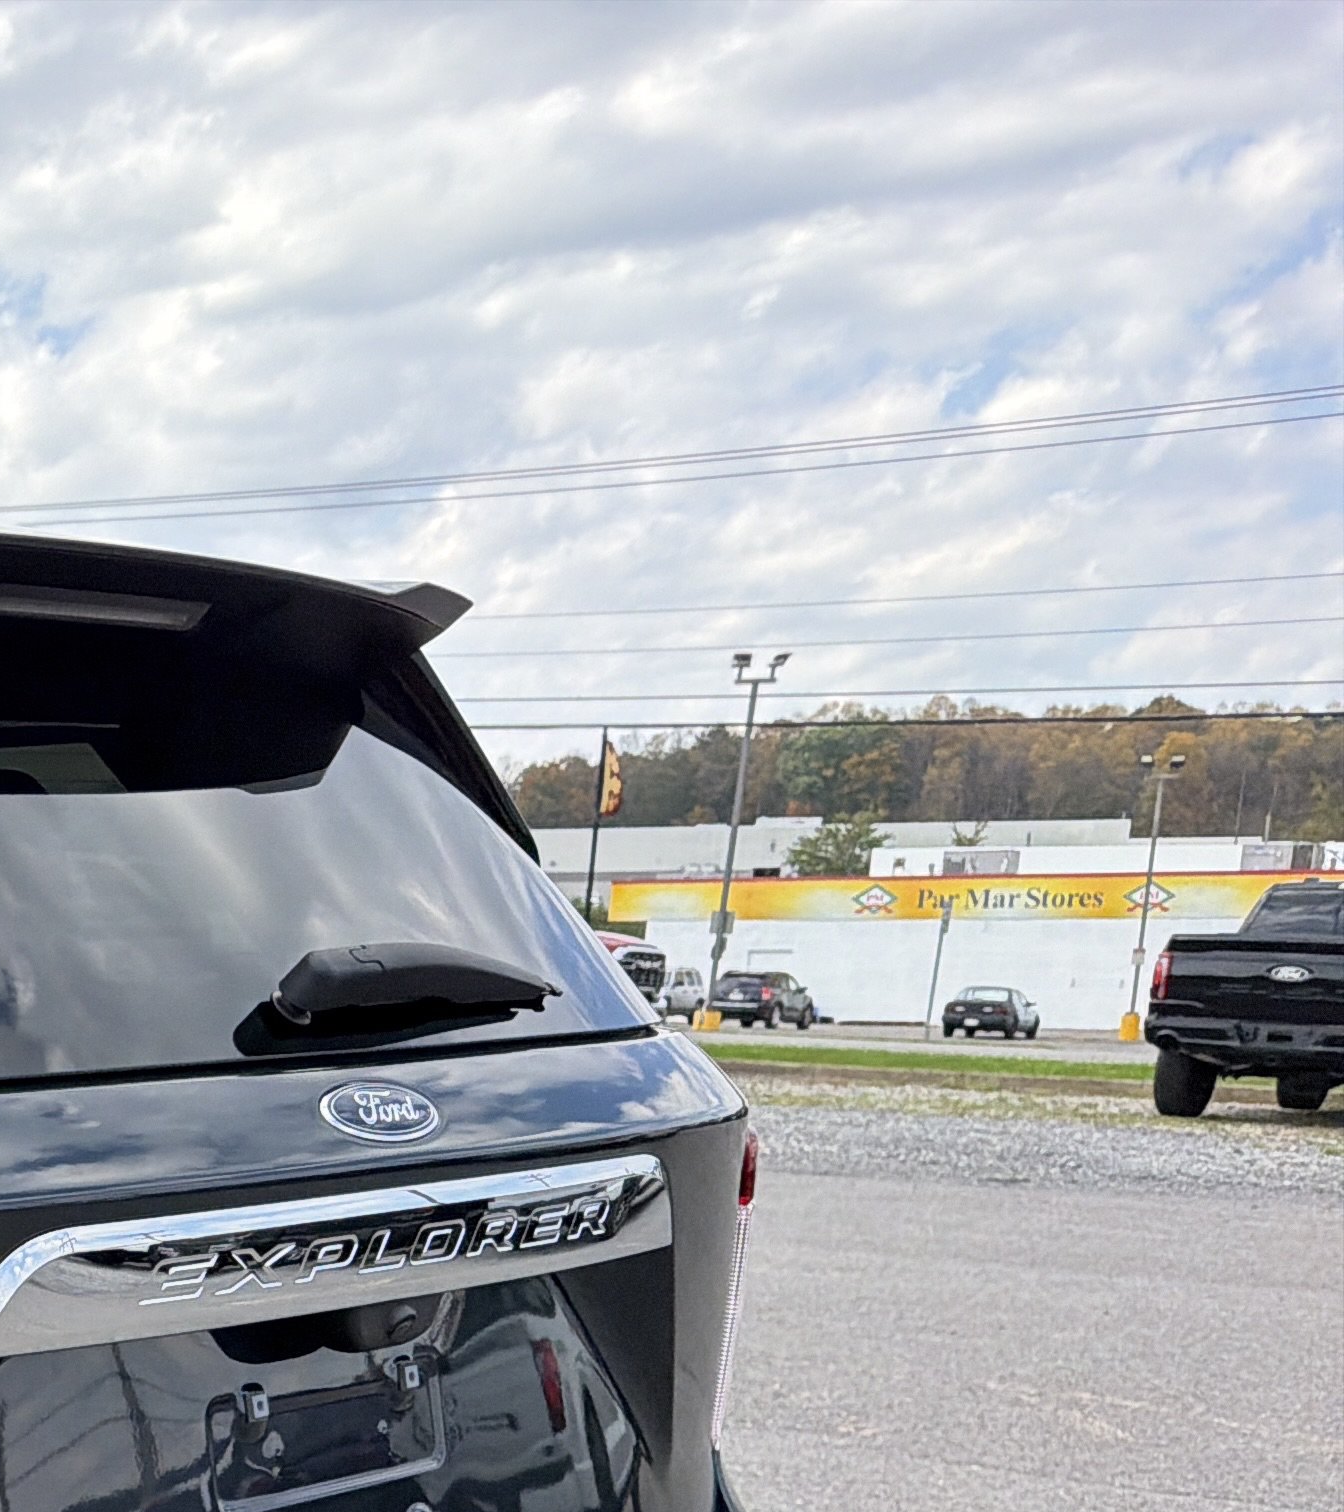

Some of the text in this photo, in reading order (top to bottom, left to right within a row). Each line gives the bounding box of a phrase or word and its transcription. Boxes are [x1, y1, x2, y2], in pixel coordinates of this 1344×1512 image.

[916, 886, 1105, 909] Par Mar Stores
[353, 1089, 420, 1125] Ford
[138, 1196, 612, 1306] EXPLORER
